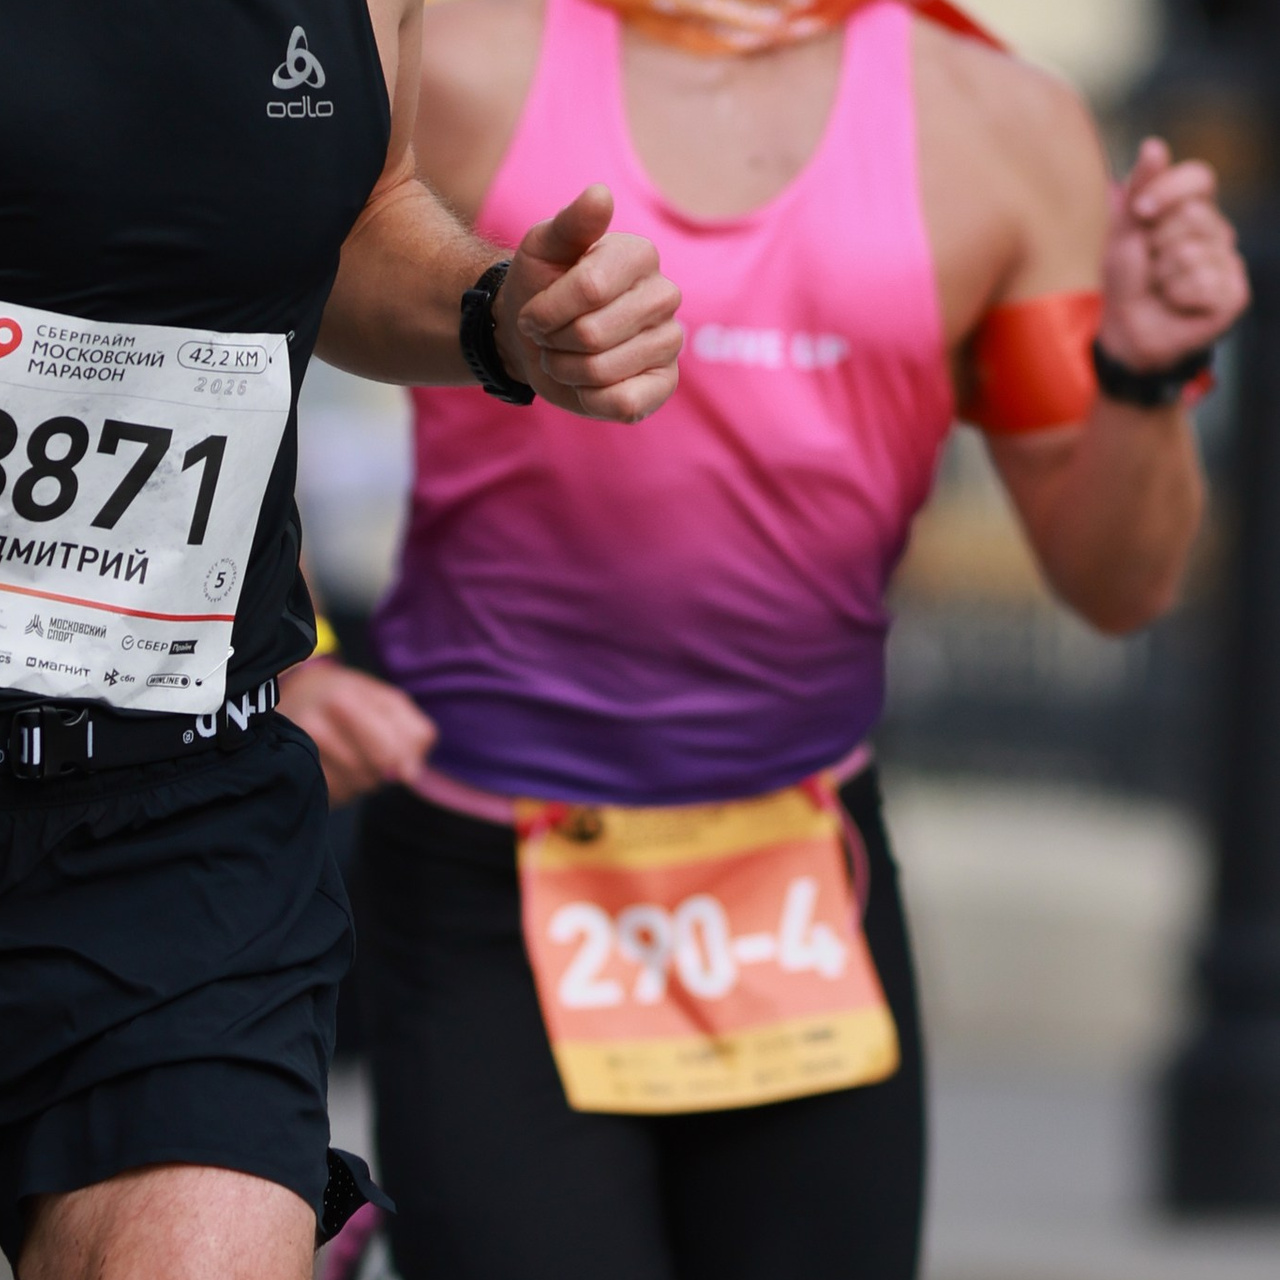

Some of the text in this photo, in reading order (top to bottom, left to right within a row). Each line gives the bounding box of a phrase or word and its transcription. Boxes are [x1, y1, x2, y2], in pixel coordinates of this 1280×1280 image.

[266, 95, 334, 118] odlo
[36, 324, 136, 348] СБЕРПРАЙМ
[31, 339, 165, 368] МОСКОВСКИЙ
[188, 347, 230, 367] 42,2
[27, 358, 126, 382] МАРАФОН
[214, 571, 227, 589] 5
[46, 628, 74, 643] СПОРТ
[48, 617, 107, 638] МОСКОВСКИЙ
[136, 639, 169, 651] СБЕР
[149, 677, 179, 685] WINLINE
[549, 876, 846, 1009] 290-4
